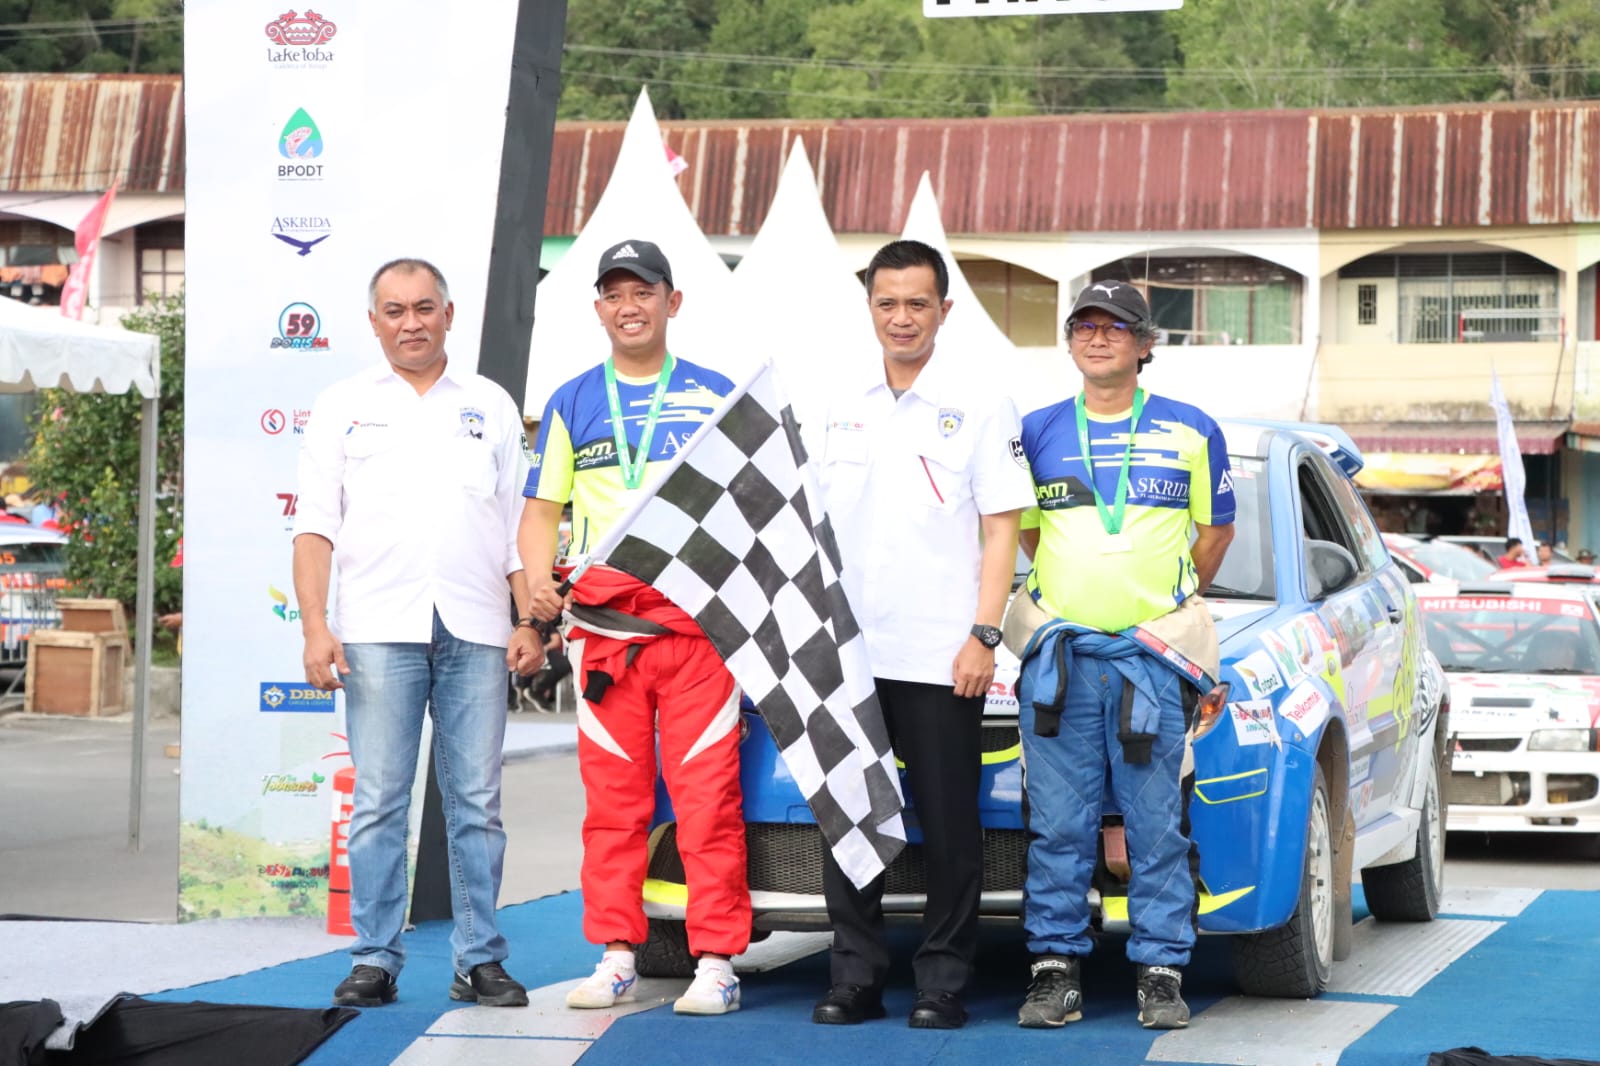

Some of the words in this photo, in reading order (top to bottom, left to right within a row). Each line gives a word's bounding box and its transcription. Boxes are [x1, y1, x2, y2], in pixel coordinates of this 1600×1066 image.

[278, 165, 324, 177] BPODT
[271, 216, 332, 232] ASKRIDA
[286, 313, 315, 336] 59
[1423, 599, 1542, 611] MITSUBISHI
[289, 689, 333, 700] DBM
